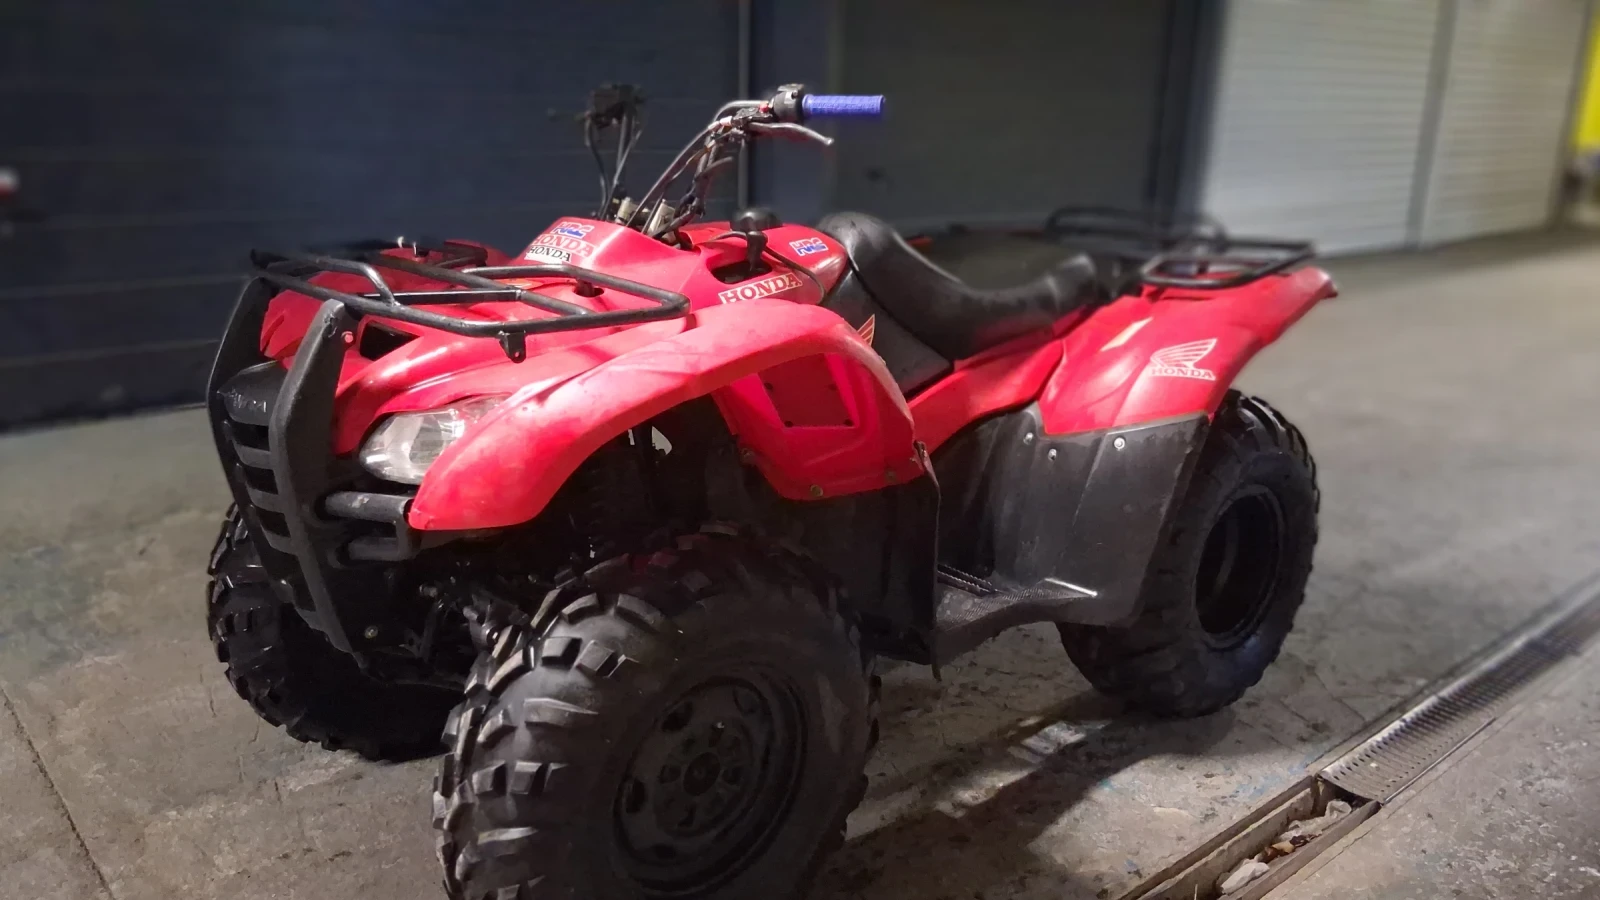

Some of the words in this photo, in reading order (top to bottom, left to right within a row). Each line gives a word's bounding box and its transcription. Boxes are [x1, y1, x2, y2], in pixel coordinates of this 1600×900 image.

[528, 246, 571, 262] HONDA
[532, 234, 595, 258] HONDA
[719, 273, 802, 303] HONDA
[1151, 367, 1213, 379] HONDA
